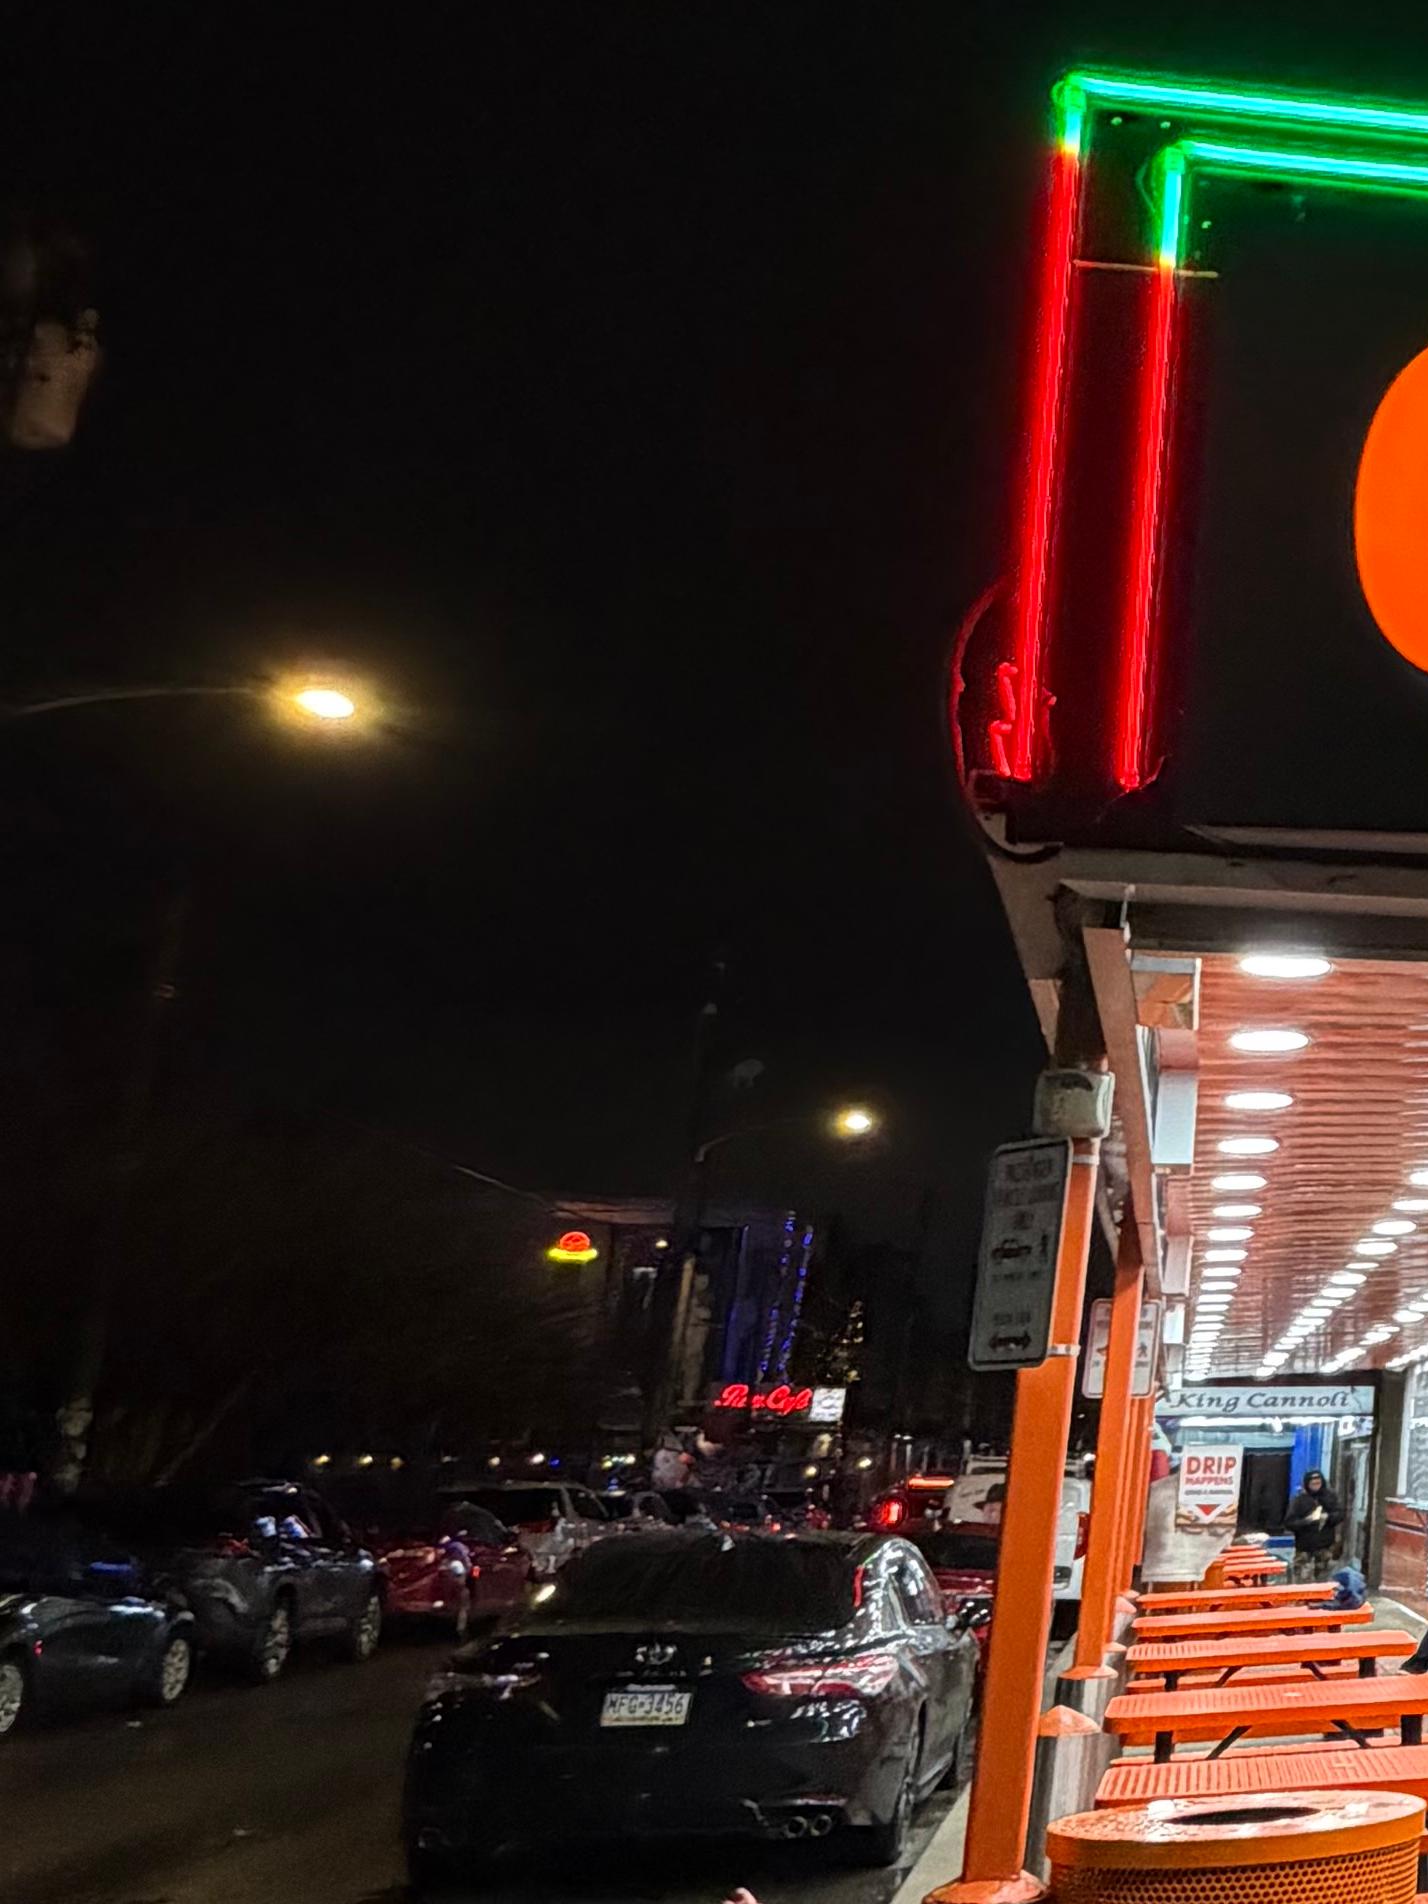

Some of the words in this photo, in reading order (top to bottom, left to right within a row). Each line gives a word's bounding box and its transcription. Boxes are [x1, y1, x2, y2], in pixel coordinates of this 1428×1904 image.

[1170, 1392, 1240, 1412] King
[1247, 1391, 1350, 1409] Cannoli
[1186, 1456, 1237, 1475] DRIP
